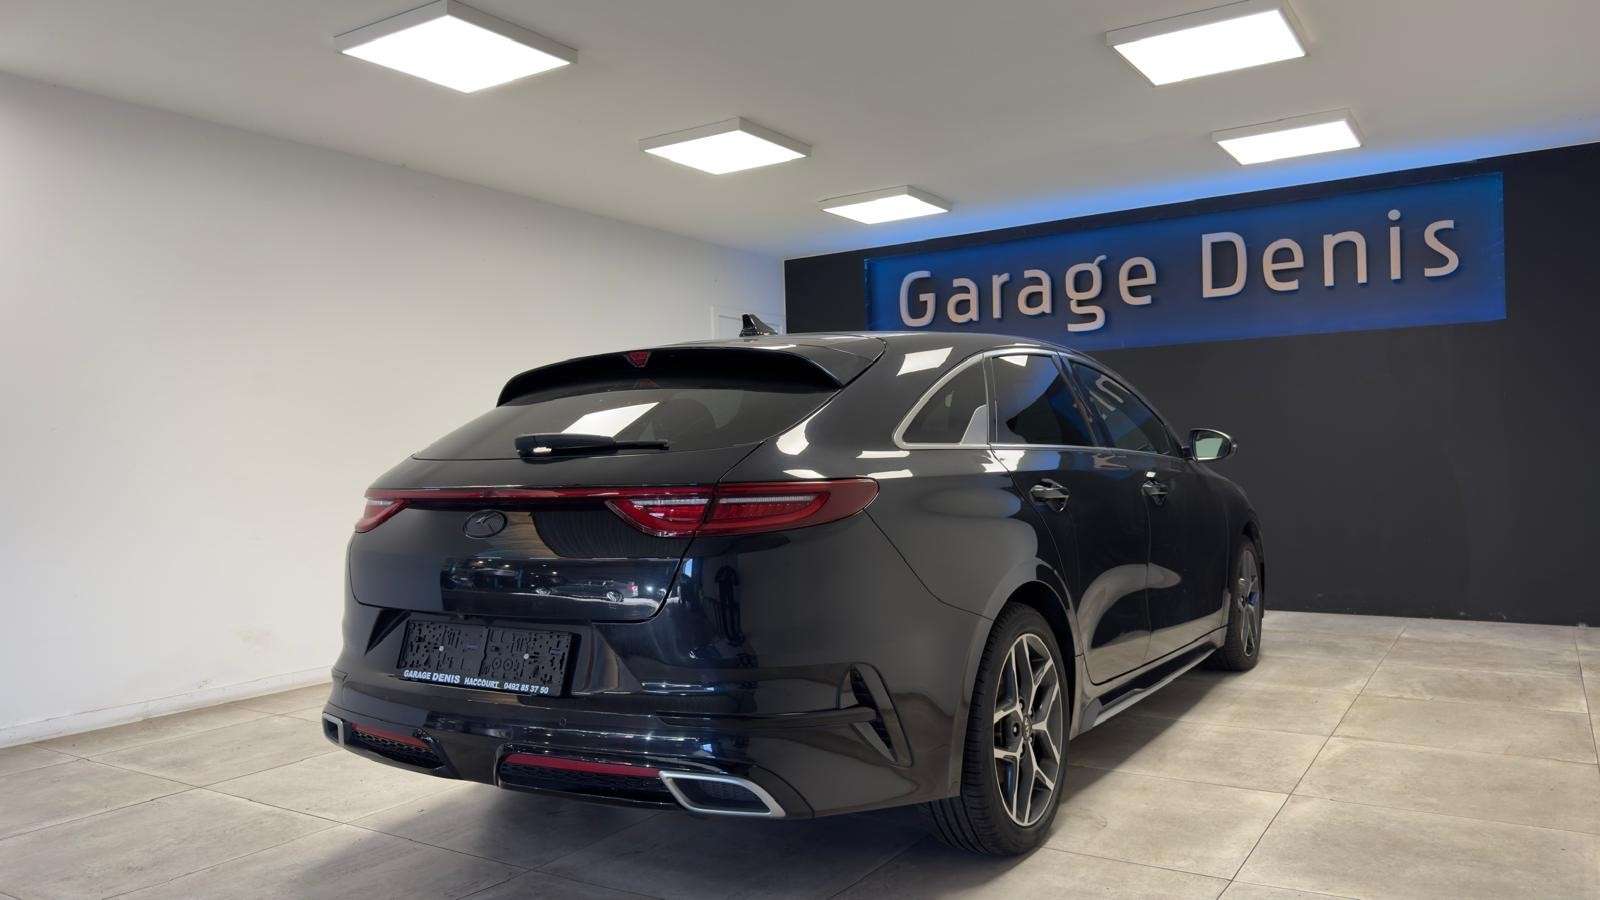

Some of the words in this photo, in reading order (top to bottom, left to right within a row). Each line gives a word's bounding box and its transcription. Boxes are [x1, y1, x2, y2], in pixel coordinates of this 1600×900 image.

[899, 254, 1157, 332] Garage
[1201, 209, 1461, 299] Denis
[403, 669, 431, 680] GARAGE
[432, 673, 460, 684] DENIS
[464, 677, 499, 689] HACCOURT
[503, 682, 520, 692] 0492
[520, 684, 529, 692] 85
[529, 685, 539, 693] 37
[539, 686, 549, 694] 50
